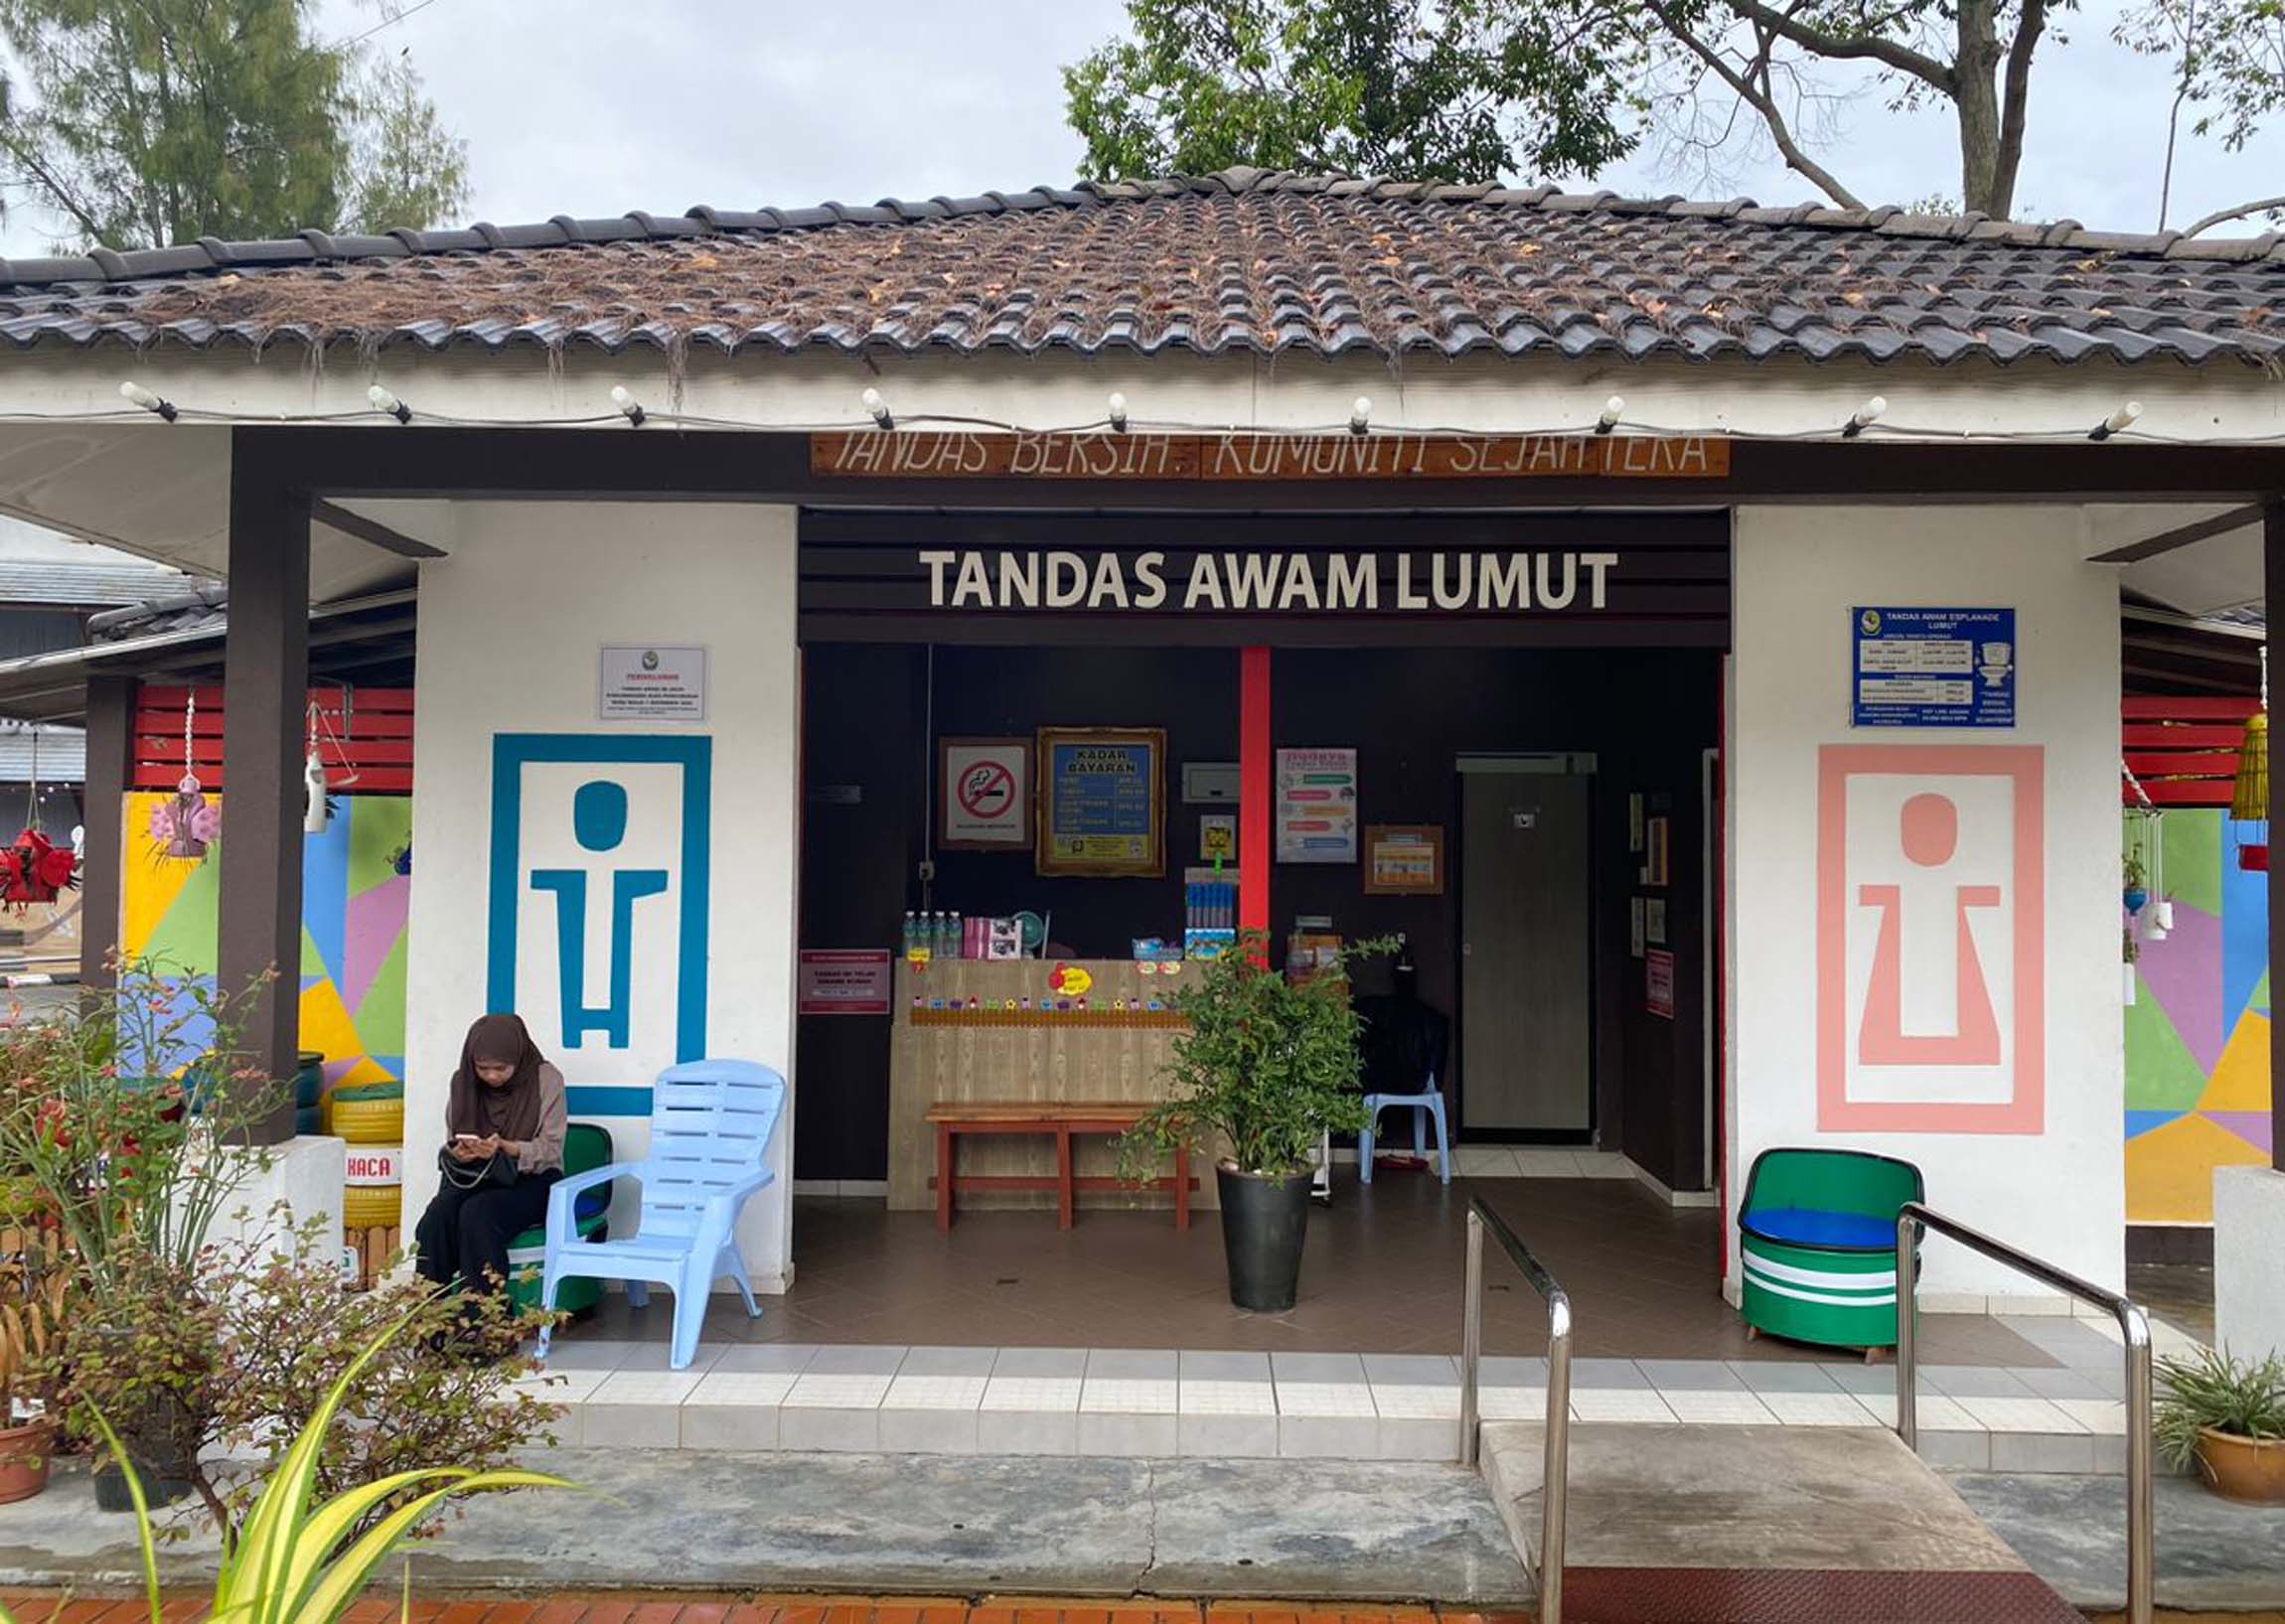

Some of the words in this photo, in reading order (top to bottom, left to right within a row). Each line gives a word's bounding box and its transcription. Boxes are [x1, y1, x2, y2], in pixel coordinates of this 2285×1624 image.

[919, 550, 1167, 608] TANDAS
[1183, 552, 1379, 610] AWAM
[1397, 552, 1619, 610] LUMUT
[1887, 612, 1920, 622] TANDAS
[1921, 613, 1947, 622] AWAM
[1927, 621, 1958, 631] LUMUT
[1076, 749, 1129, 761] KADAR
[1068, 762, 1137, 774] BAYARAN
[348, 1157, 390, 1177] KACA
